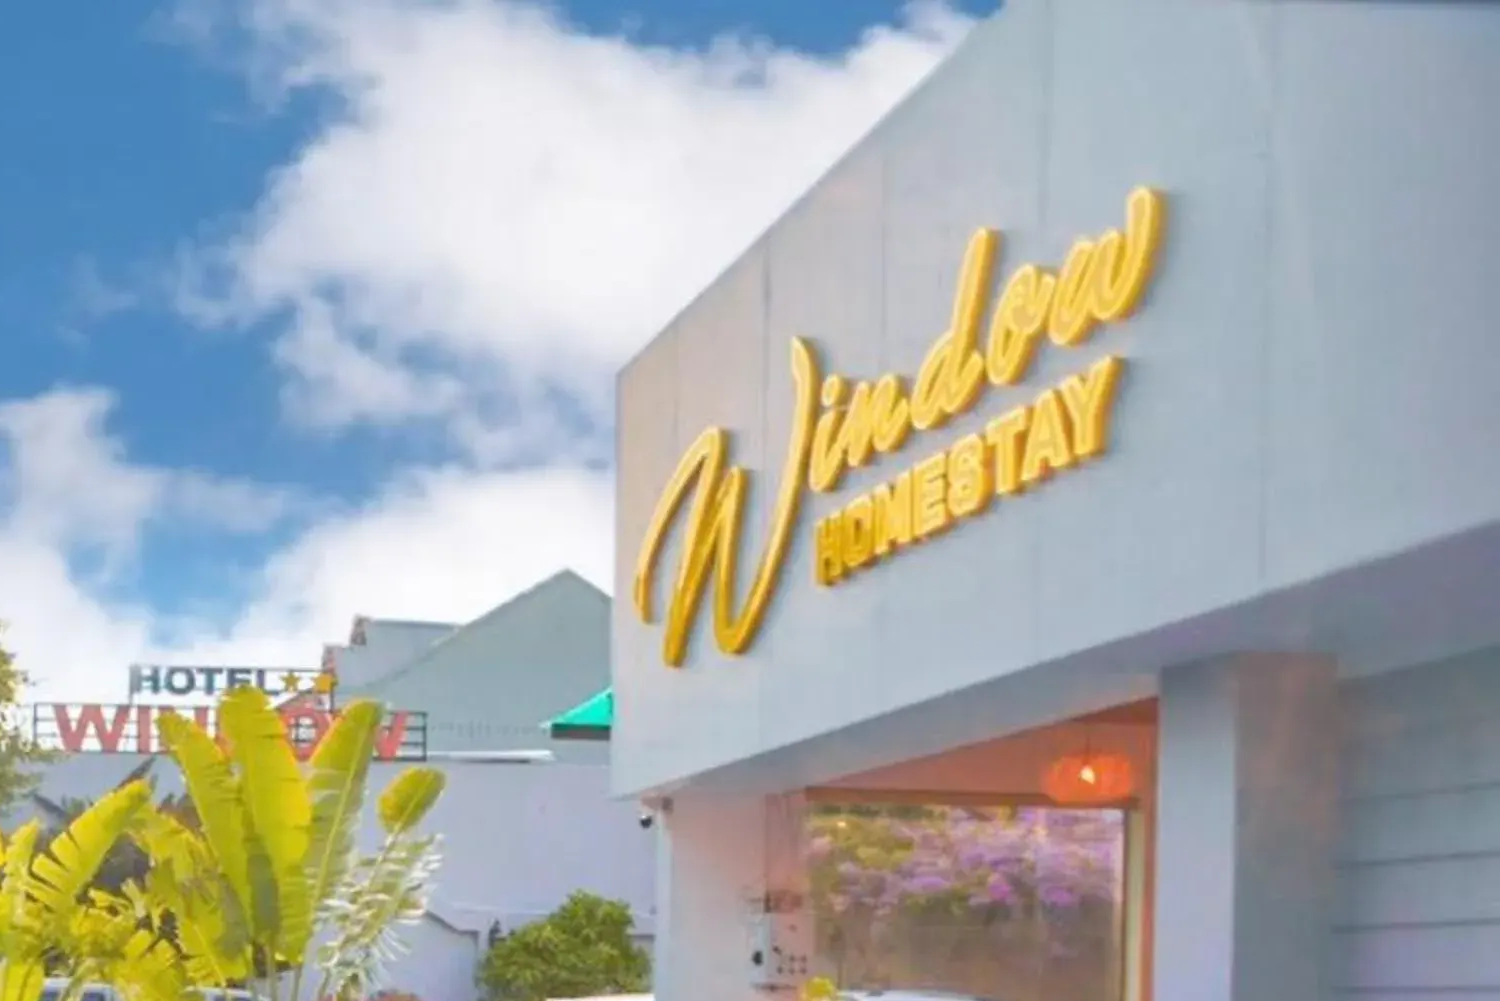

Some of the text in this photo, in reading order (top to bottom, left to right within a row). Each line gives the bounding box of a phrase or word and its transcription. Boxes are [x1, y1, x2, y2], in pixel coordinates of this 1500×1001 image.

[634, 186, 1165, 666] Window
[816, 355, 1123, 586] HOMESTAY
[130, 666, 280, 696] HOTEL
